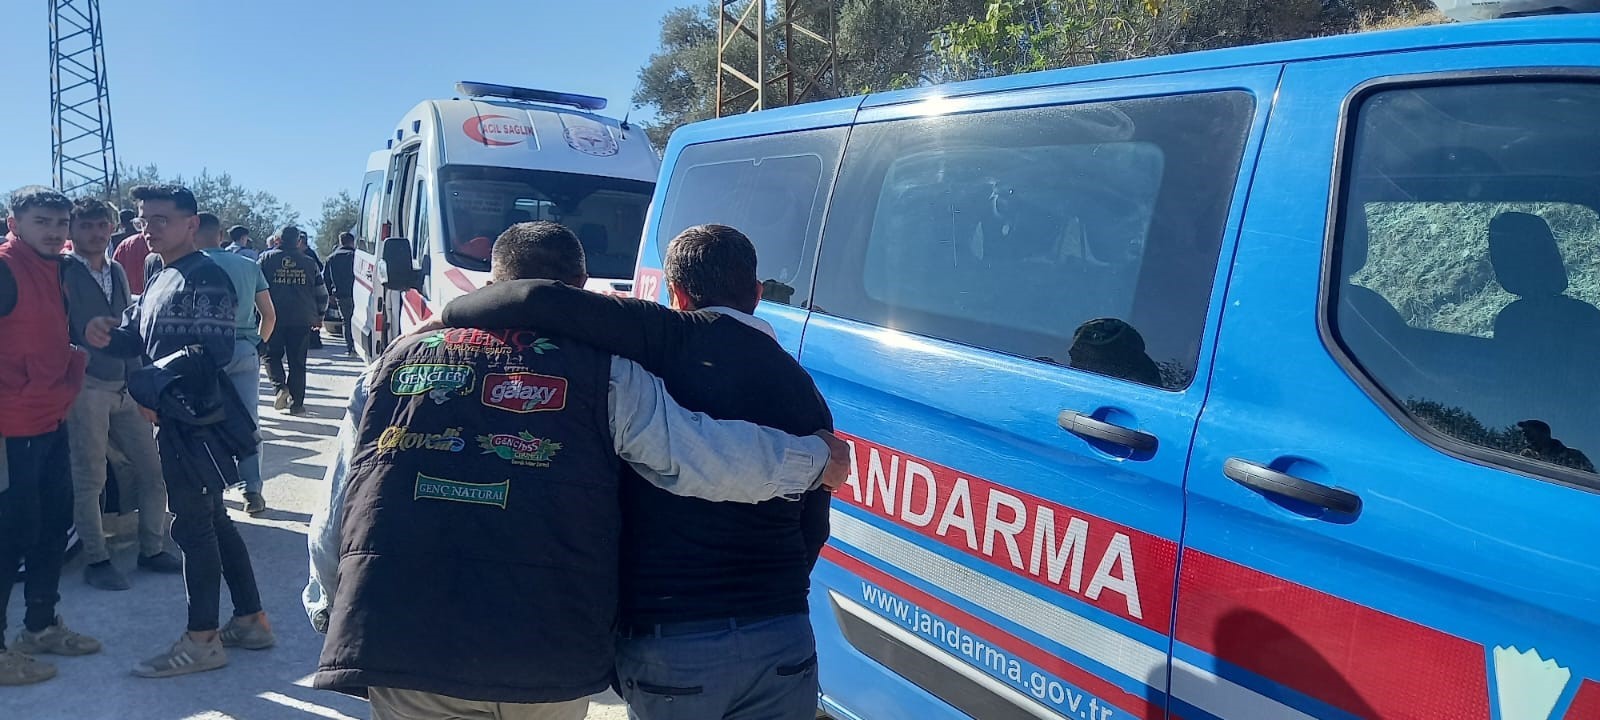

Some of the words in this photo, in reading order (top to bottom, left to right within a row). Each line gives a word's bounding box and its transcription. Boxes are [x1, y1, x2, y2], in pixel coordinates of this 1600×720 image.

[639, 274, 657, 300] 112
[491, 383, 557, 404] galaxy
[419, 483, 449, 496] GENÇ
[451, 486, 504, 500] NATURAL
[844, 439, 1142, 620] ANDARMA
[861, 581, 1113, 720] www.jandarma.gov.tr
